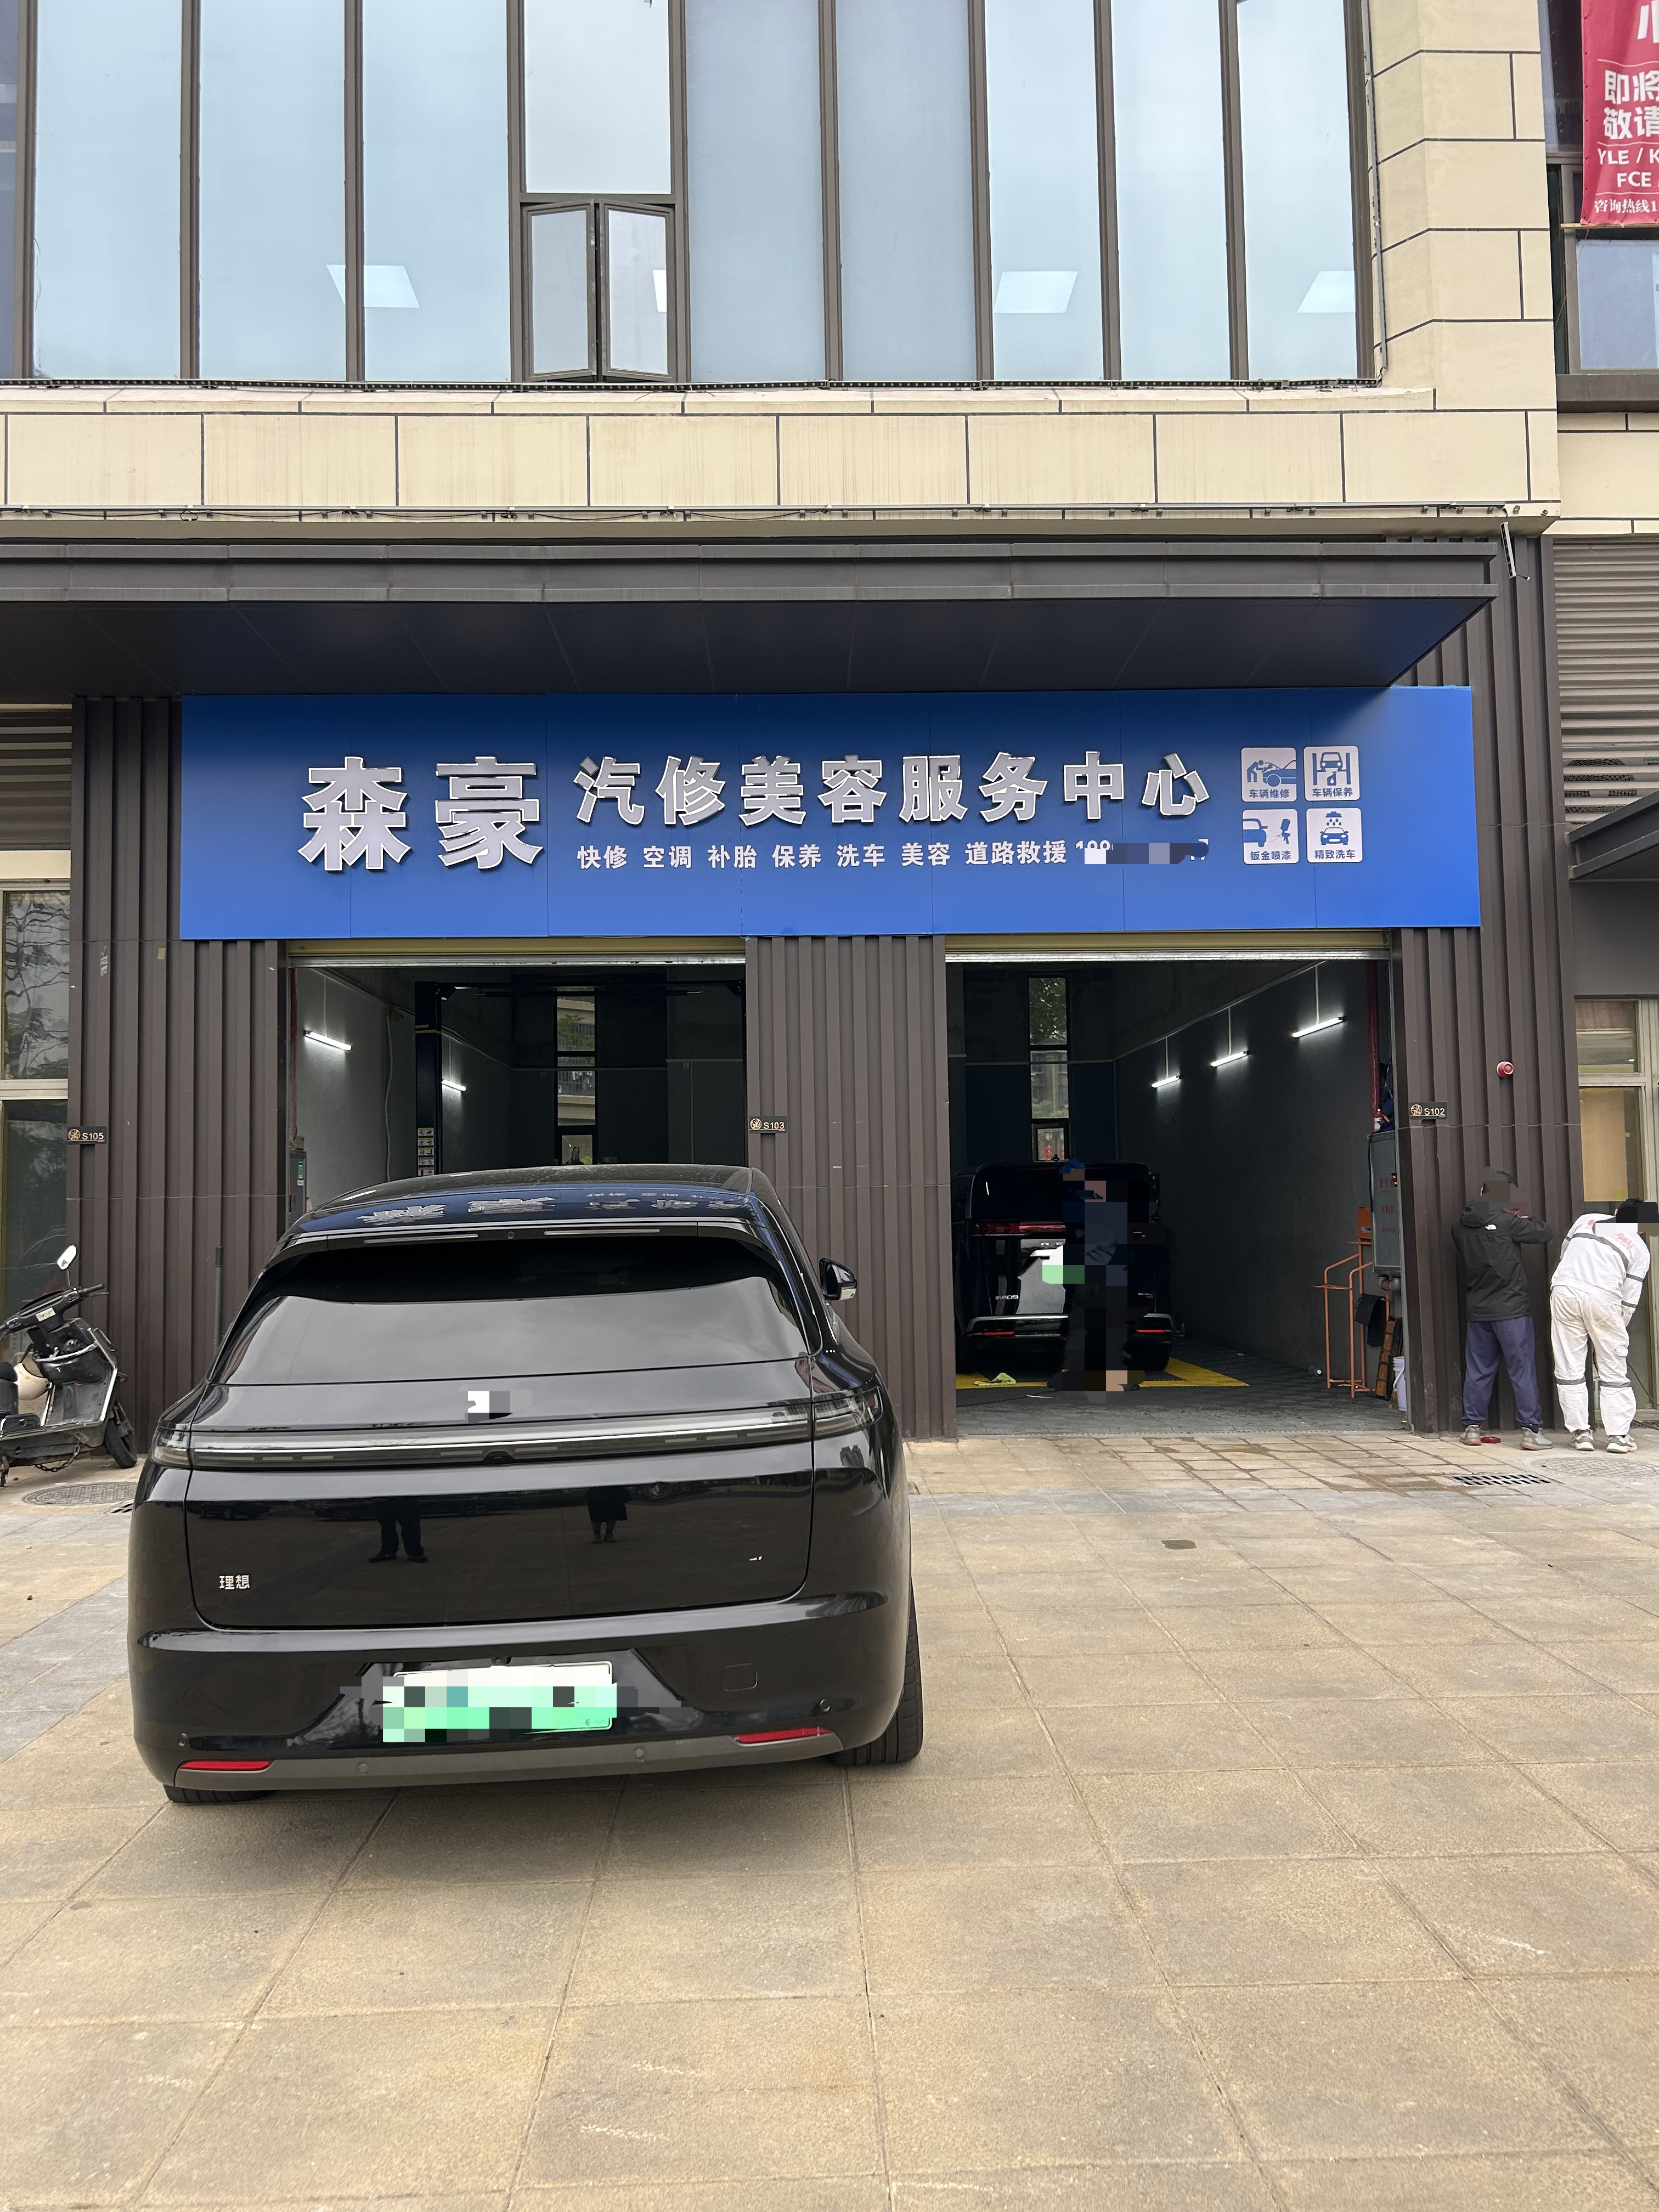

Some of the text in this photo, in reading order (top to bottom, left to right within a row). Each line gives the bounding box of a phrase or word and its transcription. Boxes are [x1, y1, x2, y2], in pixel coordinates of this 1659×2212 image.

[1605, 70, 1659, 104] 即将
[1604, 105, 1659, 139] 敬请
[1598, 148, 1629, 165] YLE
[1617, 171, 1652, 187] FCE
[1594, 199, 1659, 213] 咨询热线1
[1249, 788, 1290, 799] 车辆维修
[1312, 787, 1353, 798] 车辆保养
[298, 751, 1209, 871] 森豪 汽修美容服务中心
[577, 845, 627, 870] 快修
[643, 845, 692, 868] 空调
[707, 844, 757, 868] 补胎
[772, 844, 821, 868] 保养
[837, 843, 885, 867] 洗车
[901, 842, 951, 867] 美容
[965, 840, 1068, 865] 道路救援
[1250, 850, 1291, 860] 钣金喷漆
[1314, 849, 1356, 860] 精致洗车
[763, 1121, 785, 1130] S103
[82, 1132, 104, 1140] S105
[219, 1575, 250, 1590] 理想
